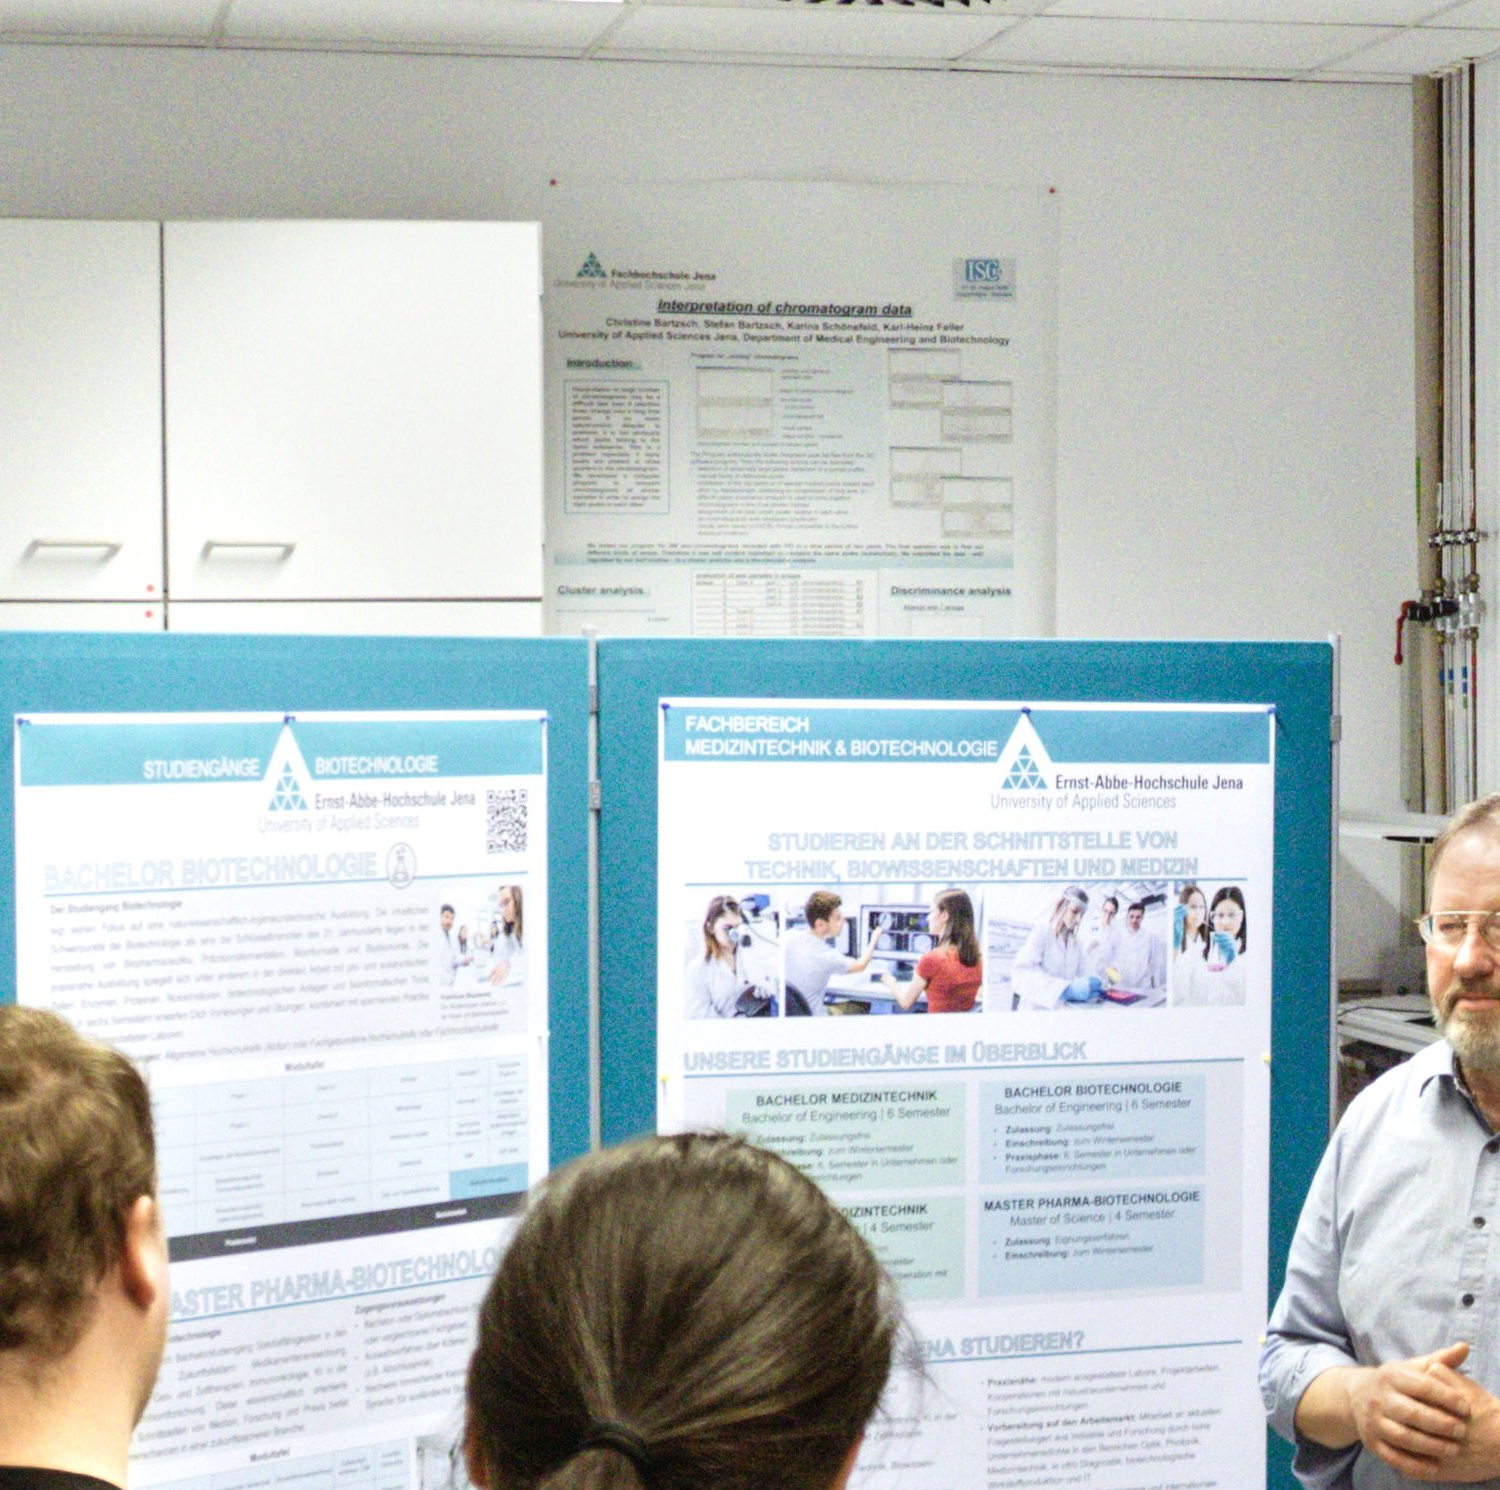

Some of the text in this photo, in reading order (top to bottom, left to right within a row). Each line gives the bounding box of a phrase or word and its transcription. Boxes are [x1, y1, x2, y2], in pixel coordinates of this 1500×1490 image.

[611, 269, 716, 281] Fachhochschule Jena
[966, 260, 999, 281] ISC
[658, 299, 912, 316] Interpretation of chromatogram data
[606, 318, 651, 328] Christine
[703, 319, 735, 329] Stefan
[787, 322, 819, 331] Karina
[884, 323, 934, 331] Karl-Heinz
[558, 331, 608, 341] University
[612, 331, 622, 339] of
[625, 331, 663, 341] Applied
[667, 332, 710, 341] Sciences
[743, 334, 800, 343] Department
[816, 335, 853, 343] Medical
[856, 335, 915, 345] Engineering
[940, 336, 1010, 346] Biotechnology
[567, 358, 633, 368] Introduction
[558, 585, 644, 597] Cluster analysis
[891, 586, 1011, 598] Discriminance analysis
[685, 715, 809, 733] FACHBEREICH
[685, 739, 998, 757] MEDIZINTECHNIK & BIOTECHNOLOGIE
[143, 755, 439, 779] STUDIENGÄNGE BIOTECHNOLOGIE
[1055, 775, 1243, 790] Ernst-Abbe-Hochschule Jena
[315, 791, 475, 810] Ernst-Abbe-Hochschule Jena
[991, 794, 1176, 811] University of Applied Sciences
[259, 813, 419, 833] University of Applied Sciences
[768, 831, 1178, 851] STUDIEREN AN DER SCHNITTSTELLE VON
[44, 851, 377, 891] BACHELOR BIOTECHNOLOGIE
[745, 857, 1198, 881] TECHNIK, BIOWISSENSCHAFTEN UND MEDIZIN
[684, 1041, 1087, 1071] UNSERE STUDIENGÄNGE IM ÜBERBLICK
[756, 1090, 937, 1107] BACHELOR MEDIZINTECHNIK
[1005, 1082, 1182, 1099] BACHELOR BIOTECHNOLOGIE
[995, 1098, 1191, 1115] Bachelor of Engineering 6 Semester
[742, 1107, 951, 1124] Bachelor of Engineering 6 Semester
[1005, 1124, 1053, 1137] Zulassung:
[849, 1143, 913, 1154] Wintersemester
[1005, 1137, 1070, 1150] Einschreibung:
[1093, 1133, 1155, 1145] Wintersemester
[1005, 1151, 1061, 1164] Praxisphase:
[984, 1190, 1200, 1211] MASTER PHARMA-BIOTECHNOLOGIE
[843, 1203, 928, 1218] DIZINTECHNIK
[1010, 1208, 1175, 1227] Master of Science 4 Semester
[870, 1221, 934, 1234] 4 Semester
[171, 1246, 499, 1316] ASTER PHARMA-BIOTECHNOLO
[961, 1331, 1085, 1356] STUDIEREN?
[988, 1419, 1043, 1432] Vorbereitung
[1062, 1417, 1078, 1427] den
[1080, 1413, 1136, 1426] Arbeitsmarkt:
